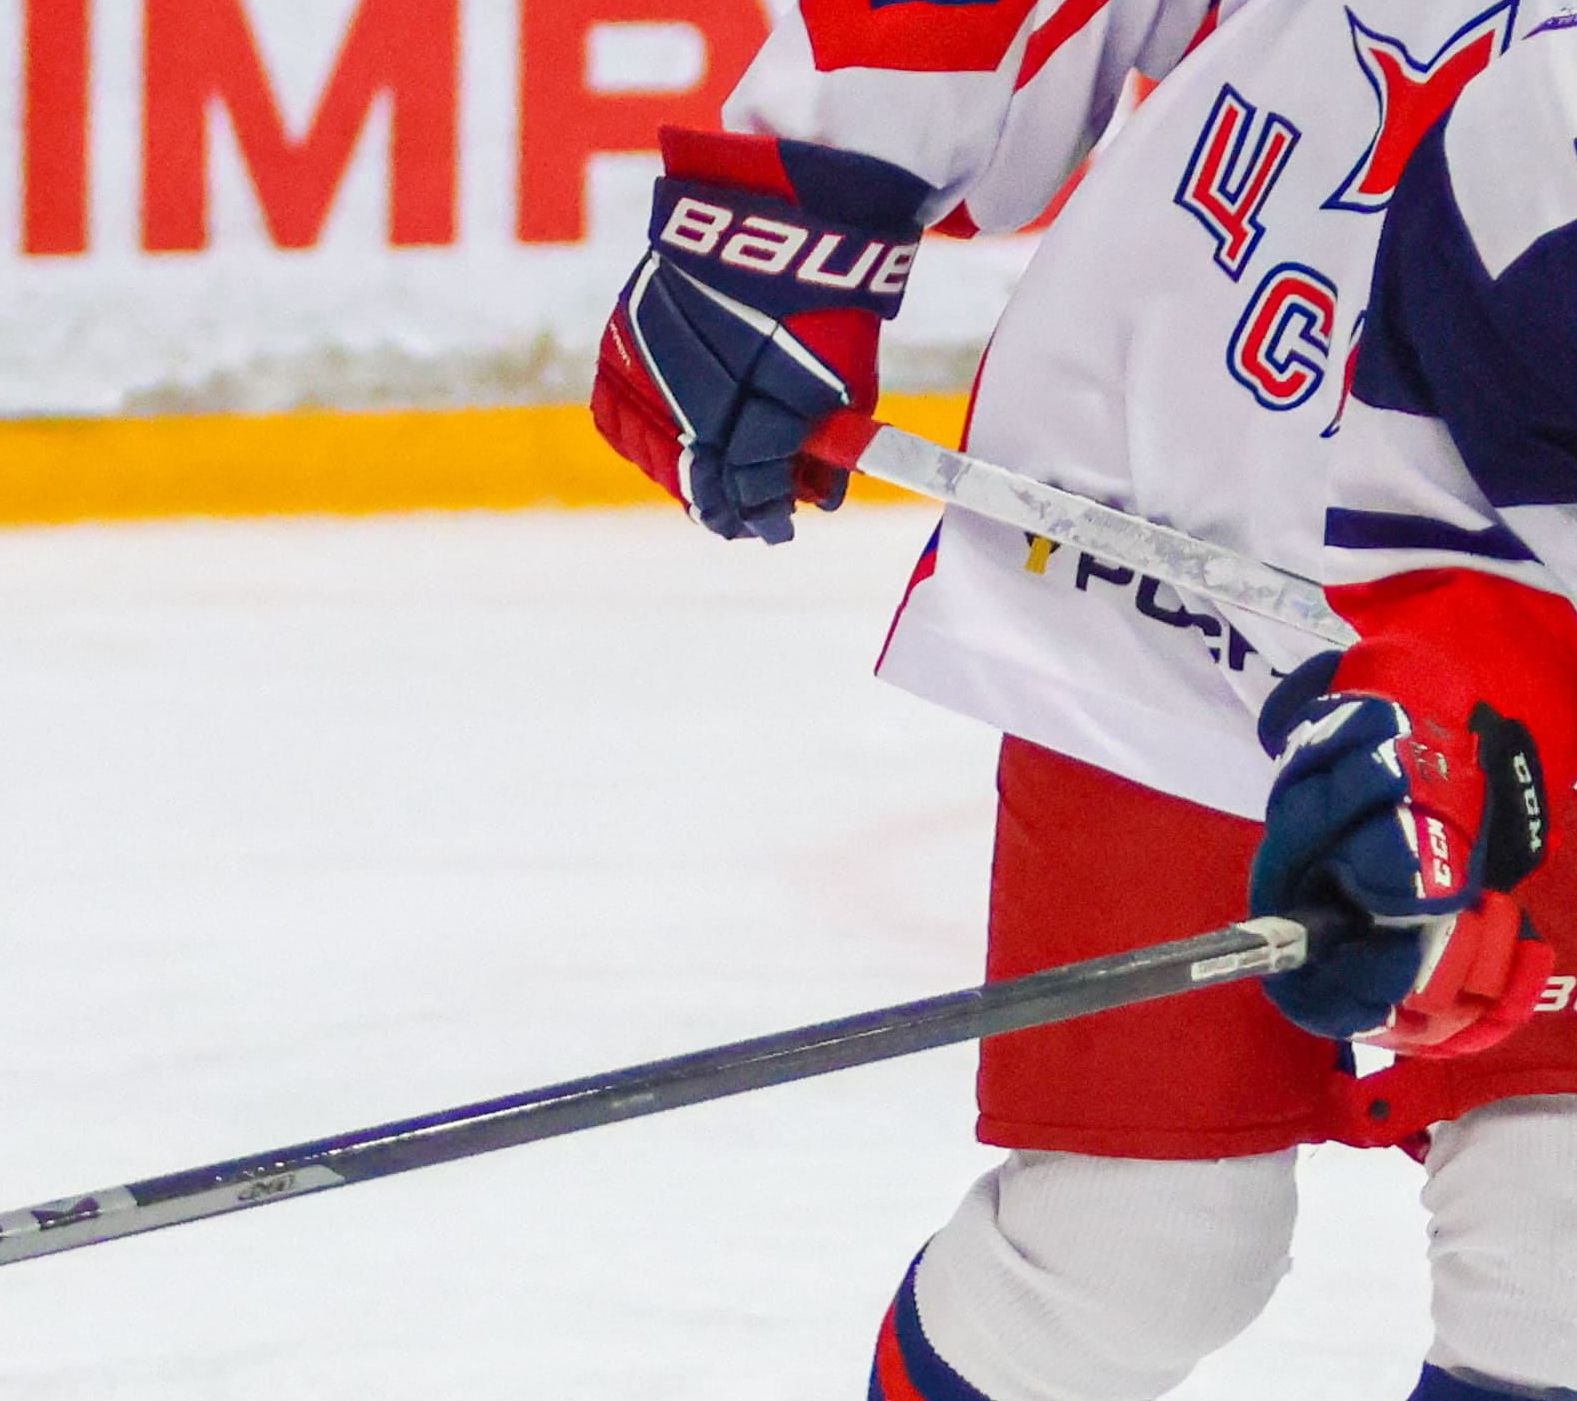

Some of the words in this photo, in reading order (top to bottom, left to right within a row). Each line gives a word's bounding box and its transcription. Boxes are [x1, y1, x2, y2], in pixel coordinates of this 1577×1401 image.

[659, 196, 921, 295] BAUE
[1512, 750, 1543, 854] CCM
[1425, 815, 1453, 889] CCM
